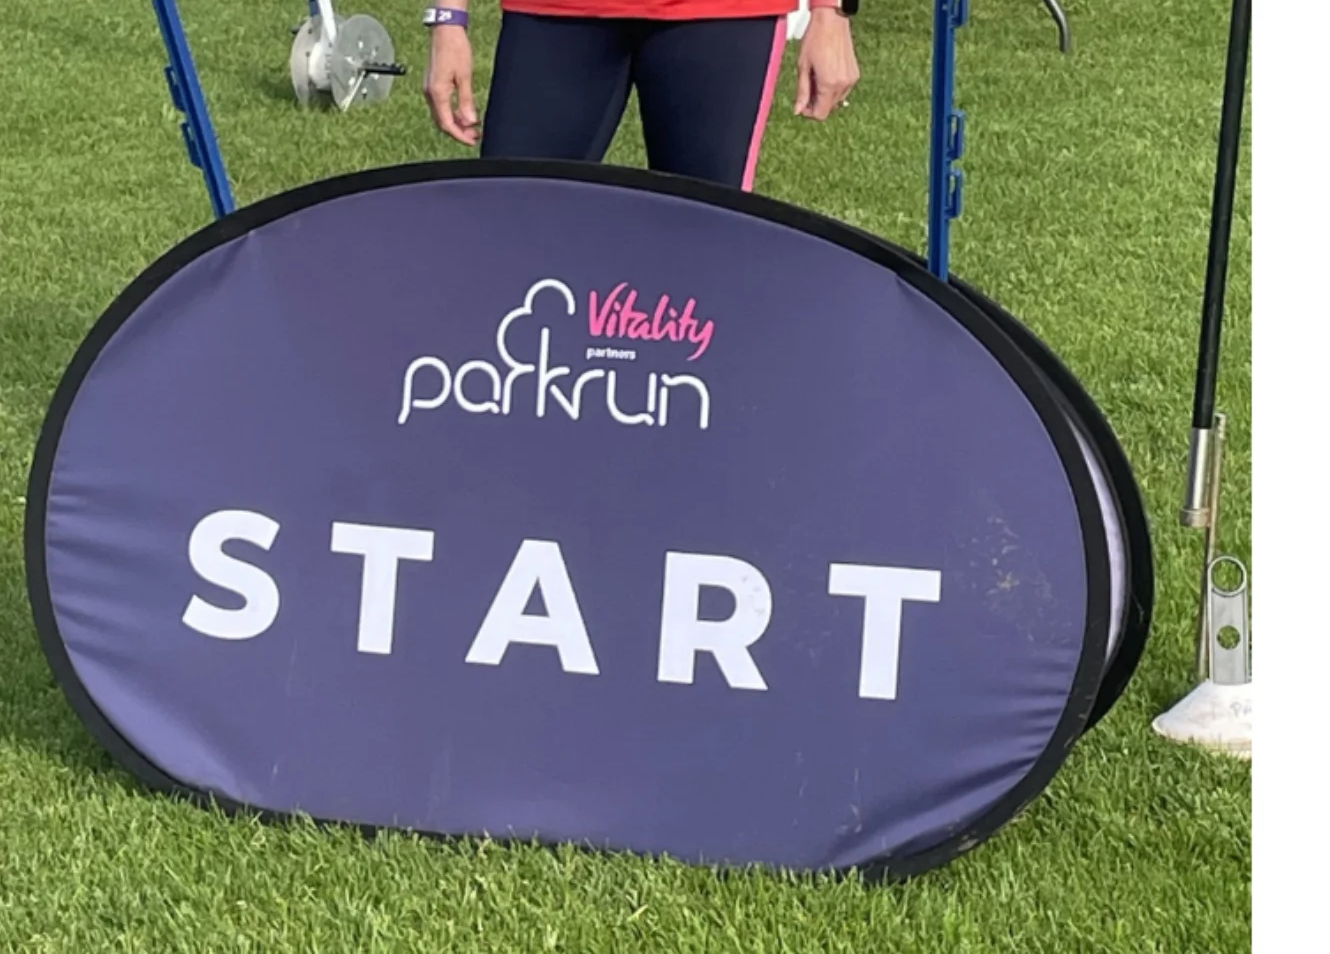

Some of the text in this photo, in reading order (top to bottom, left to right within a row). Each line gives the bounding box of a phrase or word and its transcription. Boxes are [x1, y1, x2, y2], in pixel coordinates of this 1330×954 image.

[397, 278, 711, 430] parkrun
[586, 347, 636, 361] partners
[588, 282, 715, 361] Vitality
[181, 509, 943, 701] START
